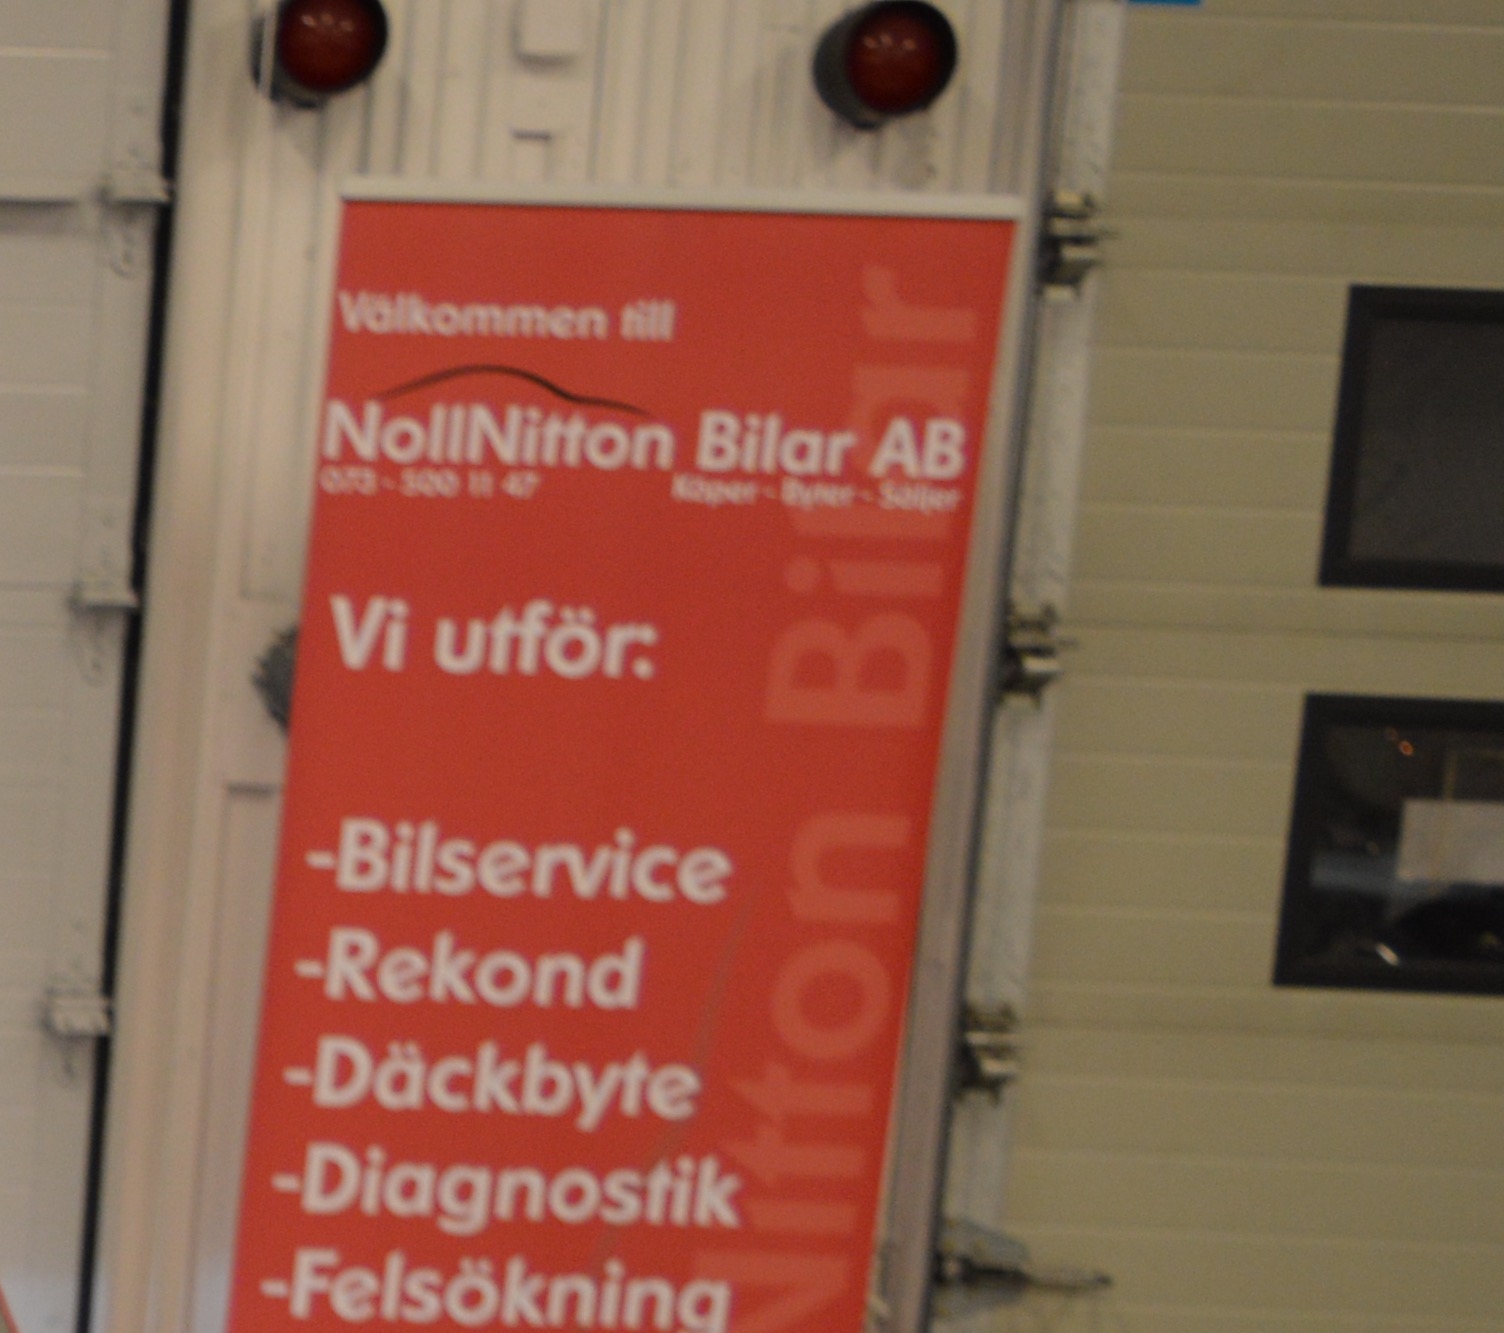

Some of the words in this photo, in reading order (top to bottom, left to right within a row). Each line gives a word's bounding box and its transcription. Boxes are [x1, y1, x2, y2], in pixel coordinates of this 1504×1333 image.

[321, 398, 675, 470] NollNitton
[697, 410, 855, 475] Bilar
[869, 417, 966, 480] AB
[330, 594, 408, 671] Vi
[434, 601, 657, 680] utför:
[305, 817, 734, 903] -Bilservice
[295, 926, 645, 1010] -Rekond
[283, 1034, 701, 1132] -Däckbyte
[273, 1142, 744, 1236] -Diagnostik
